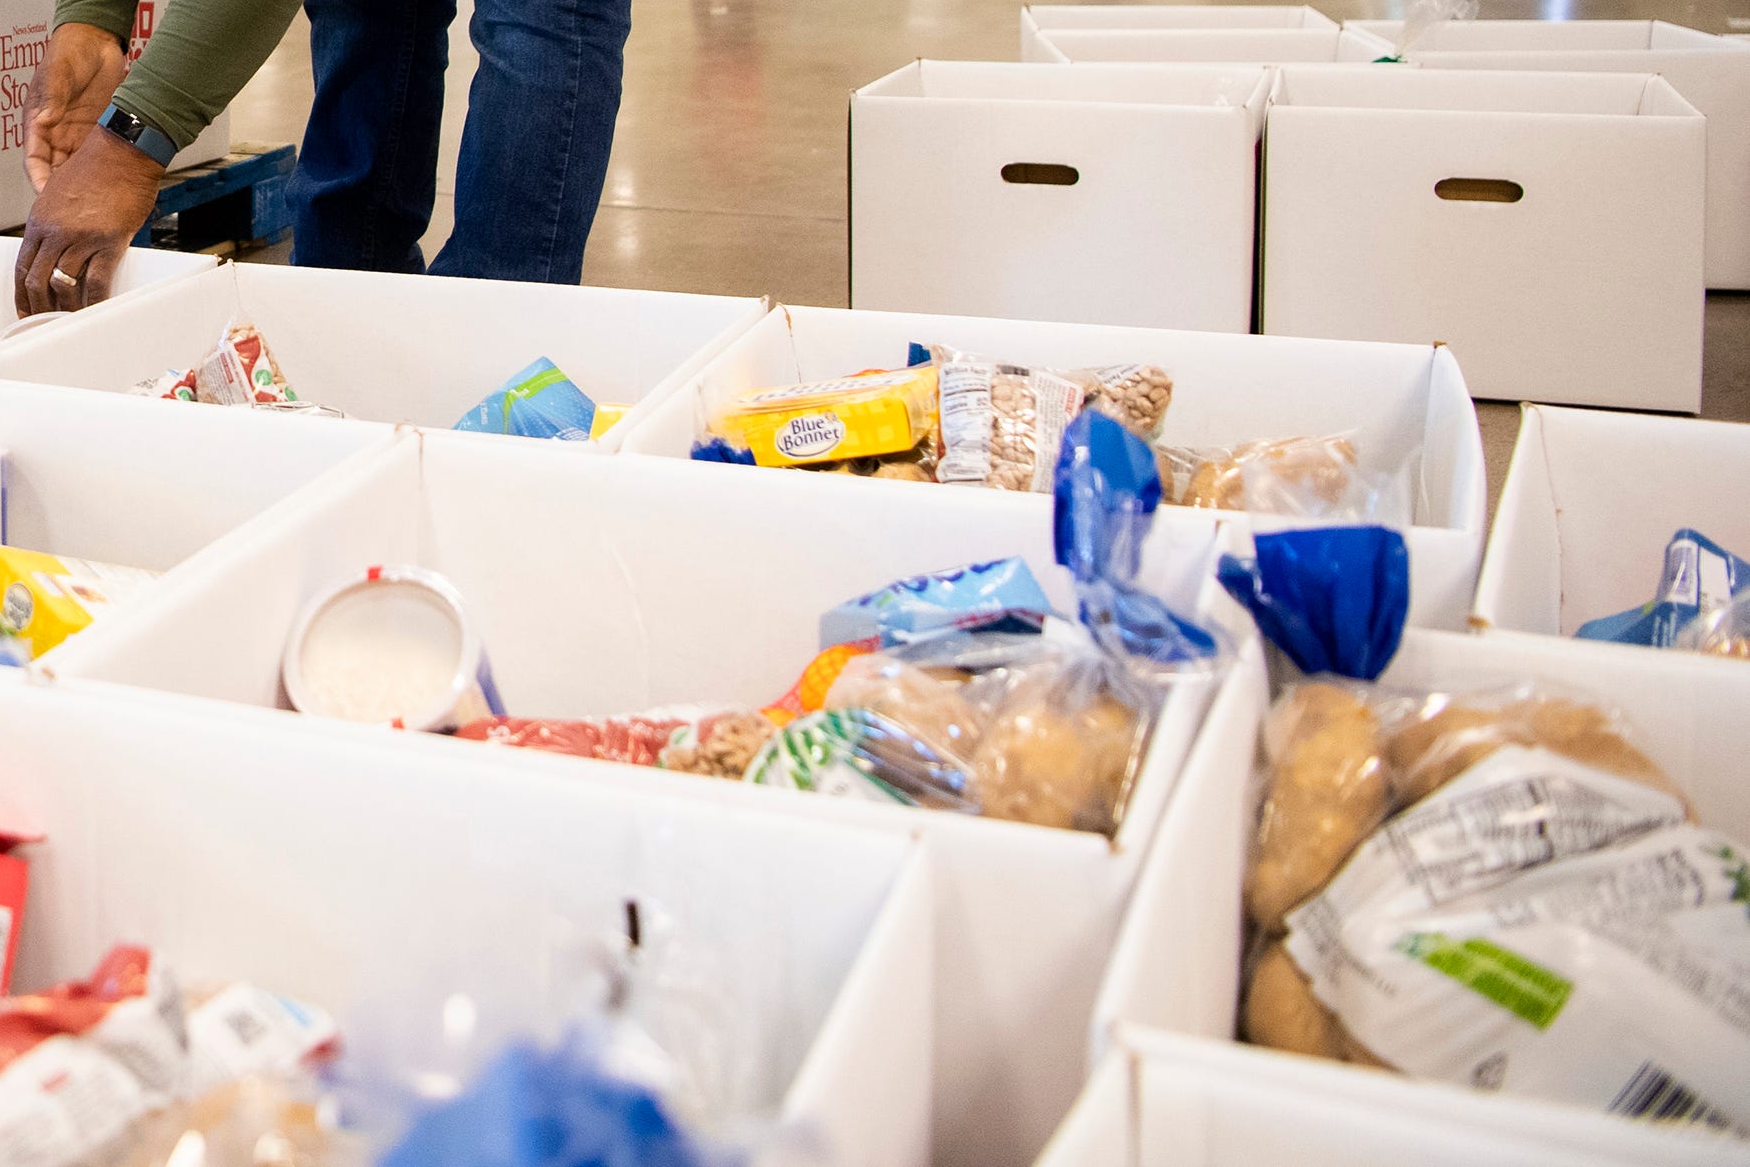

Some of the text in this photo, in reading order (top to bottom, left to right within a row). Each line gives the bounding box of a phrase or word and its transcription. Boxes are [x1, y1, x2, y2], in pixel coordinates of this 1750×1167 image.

[0, 34, 51, 73] Empt
[1, 113, 24, 151] Fu
[783, 427, 840, 452] Bonnet
[791, 418, 825, 435] Blue
